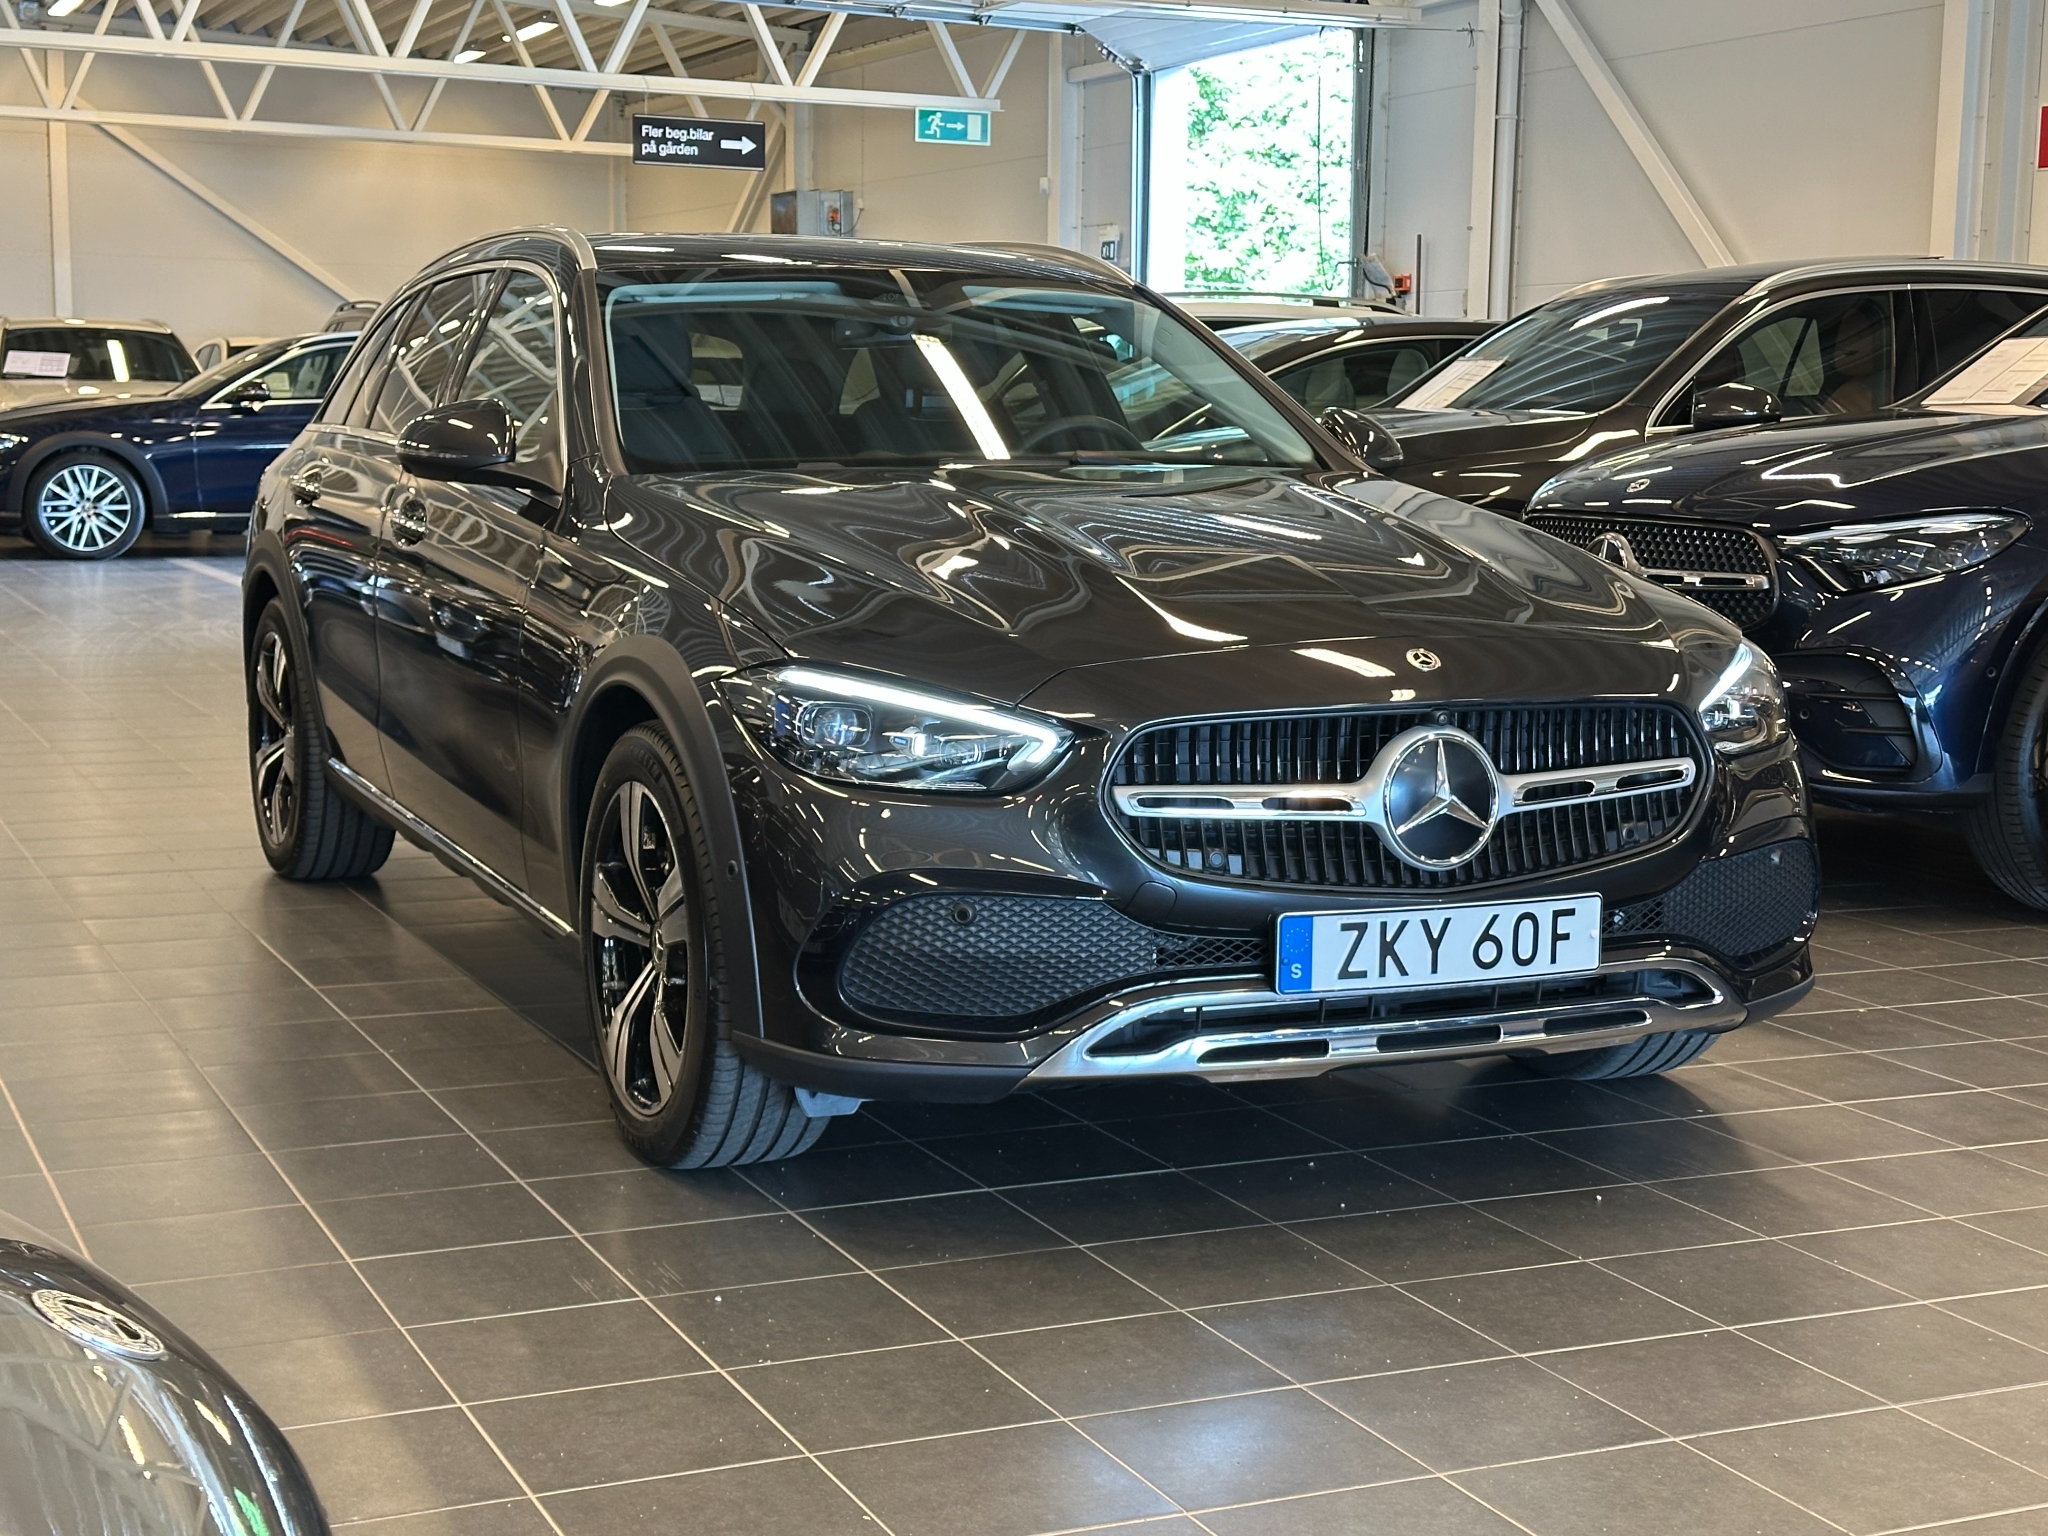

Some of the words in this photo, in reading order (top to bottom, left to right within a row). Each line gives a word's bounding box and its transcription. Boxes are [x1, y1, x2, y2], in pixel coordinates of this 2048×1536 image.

[641, 125, 664, 138] Fler
[665, 126, 714, 141] beg.bilar
[641, 140, 657, 155] på
[659, 141, 698, 156] gården
[1337, 917, 1452, 980] ZKY
[1472, 908, 1576, 970] 60F
[1290, 963, 1302, 979] S
